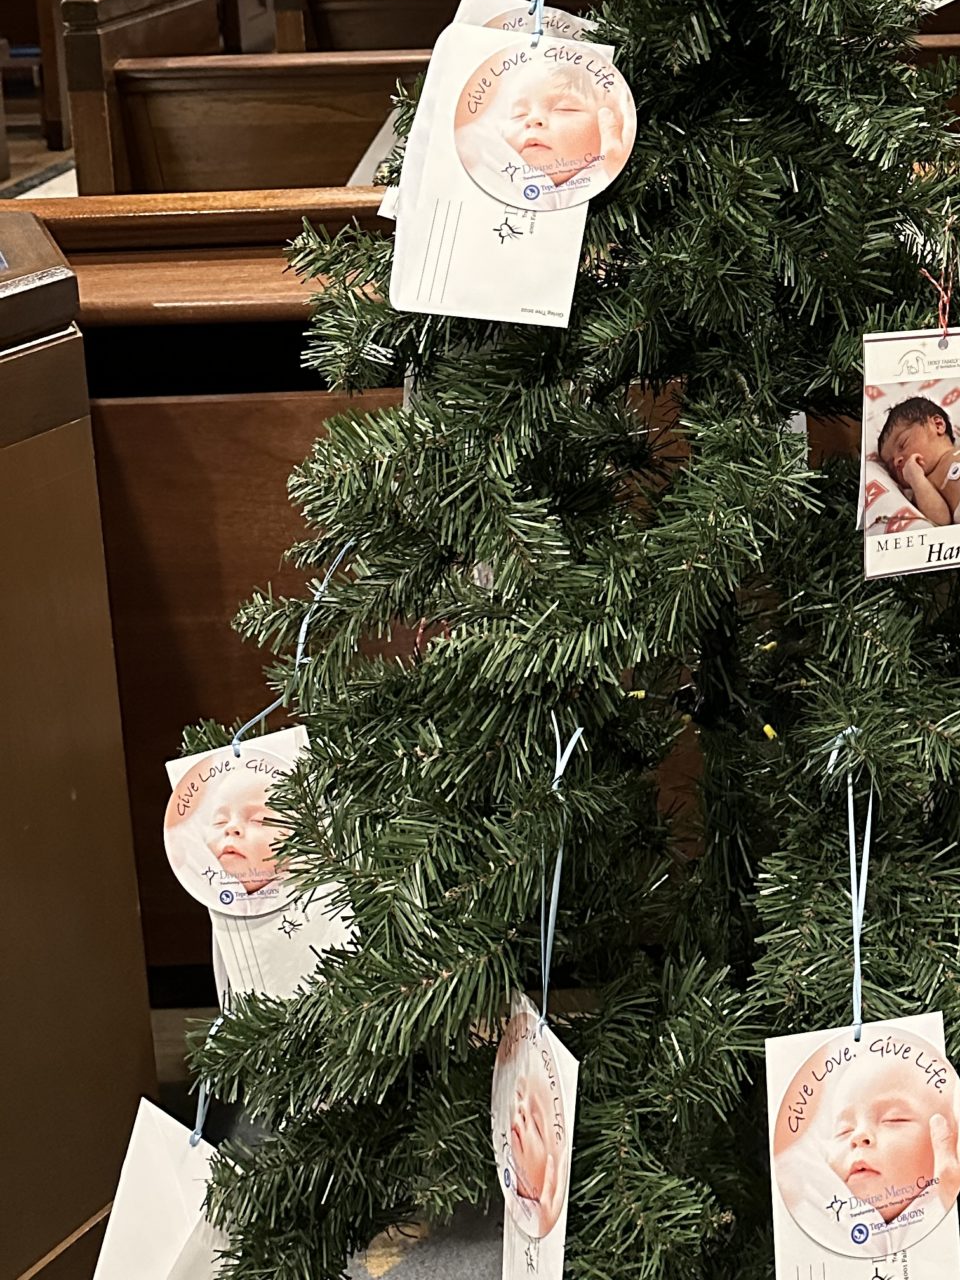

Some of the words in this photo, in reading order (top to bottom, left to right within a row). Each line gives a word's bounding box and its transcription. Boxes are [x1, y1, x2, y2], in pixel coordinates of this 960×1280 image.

[502, 17, 528, 31] ove.
[541, 16, 571, 33] Give
[467, 77, 492, 114] Give
[490, 51, 532, 77] Love.
[544, 46, 583, 65] Give
[586, 59, 615, 93] Life.
[522, 163, 553, 175] Divine
[584, 152, 606, 163] Care
[876, 534, 927, 552] MEET
[177, 782, 199, 816] Give
[199, 760, 235, 782] Love.
[245, 759, 279, 778] Give
[541, 1050, 556, 1091] Give
[553, 1097, 564, 1145] Life.
[788, 1084, 814, 1133] Give
[812, 1047, 857, 1081] Love.
[869, 1035, 912, 1060] Give
[915, 1051, 947, 1094] Life.
[848, 1194, 883, 1210] Divine
[884, 1185, 915, 1200] Mercy
[916, 1176, 940, 1190] Care
[896, 1208, 925, 1223] OB/GYN
